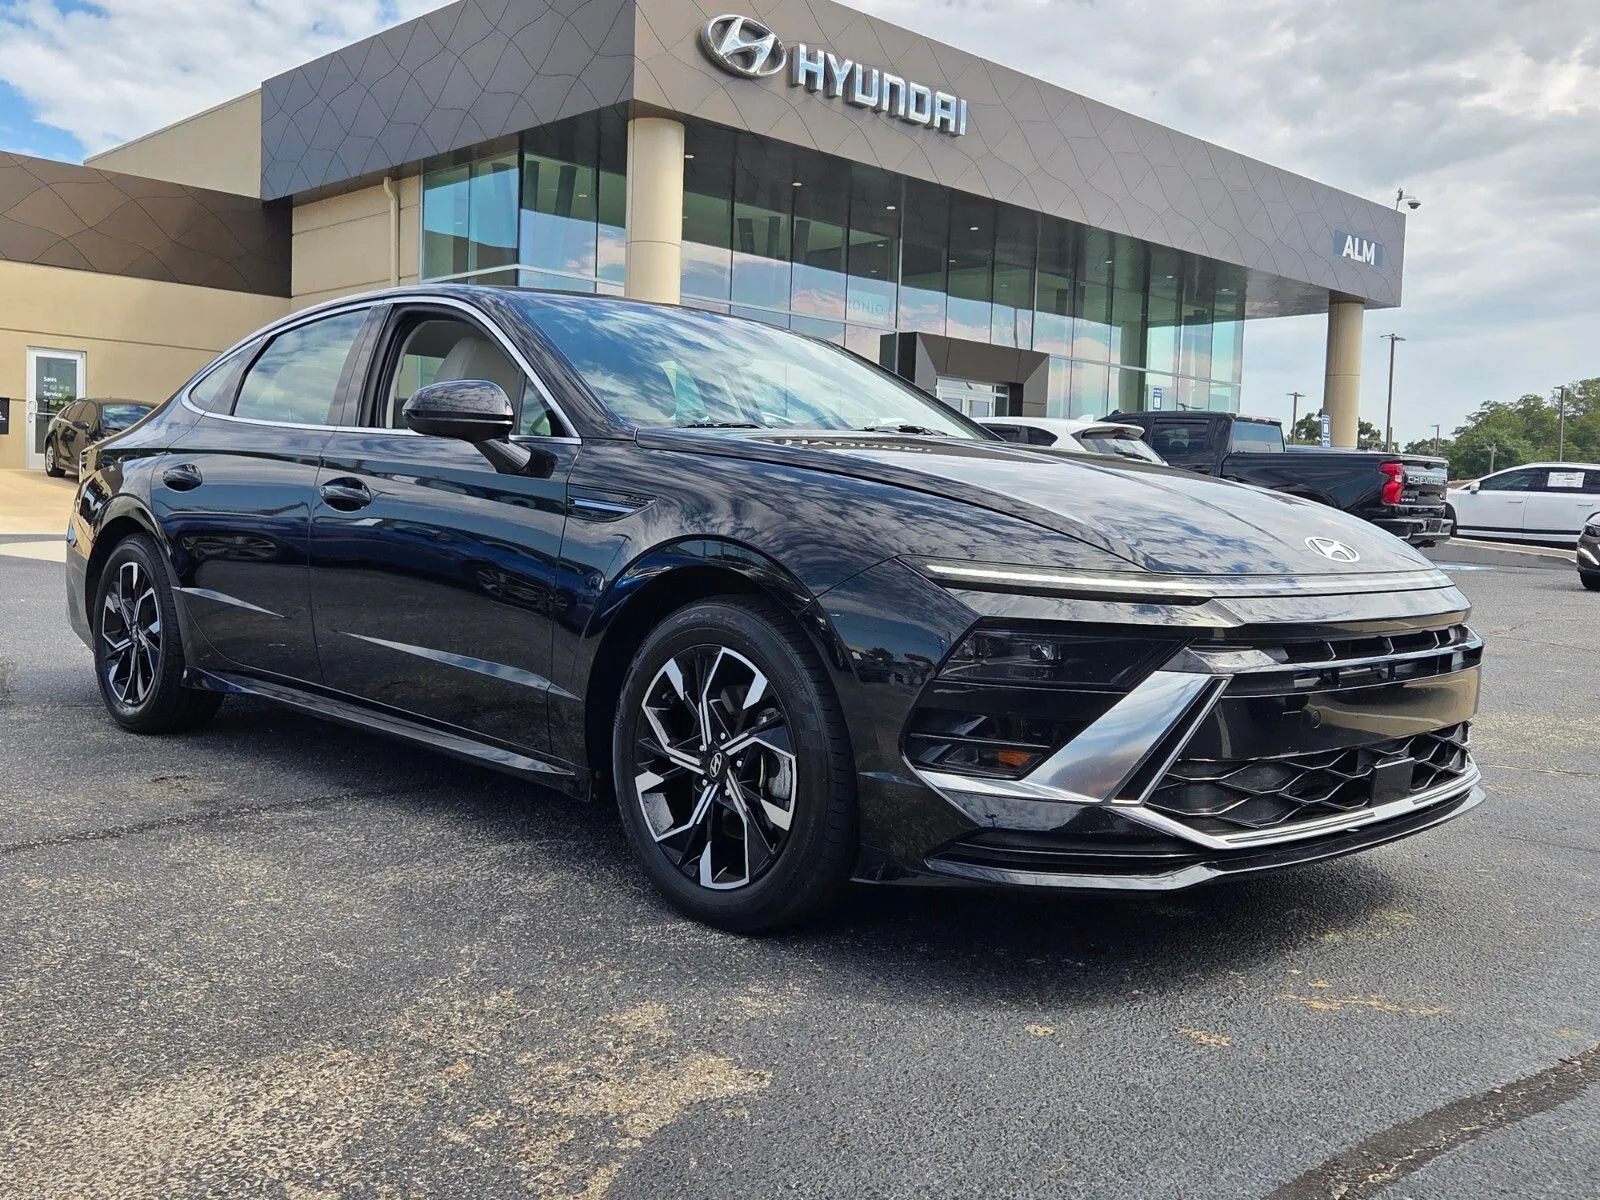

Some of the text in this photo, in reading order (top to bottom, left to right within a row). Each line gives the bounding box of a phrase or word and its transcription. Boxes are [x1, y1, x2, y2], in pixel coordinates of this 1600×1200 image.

[793, 43, 967, 136] HYUNDAI
[1342, 234, 1376, 266] ALM
[43, 390, 62, 398] Service
